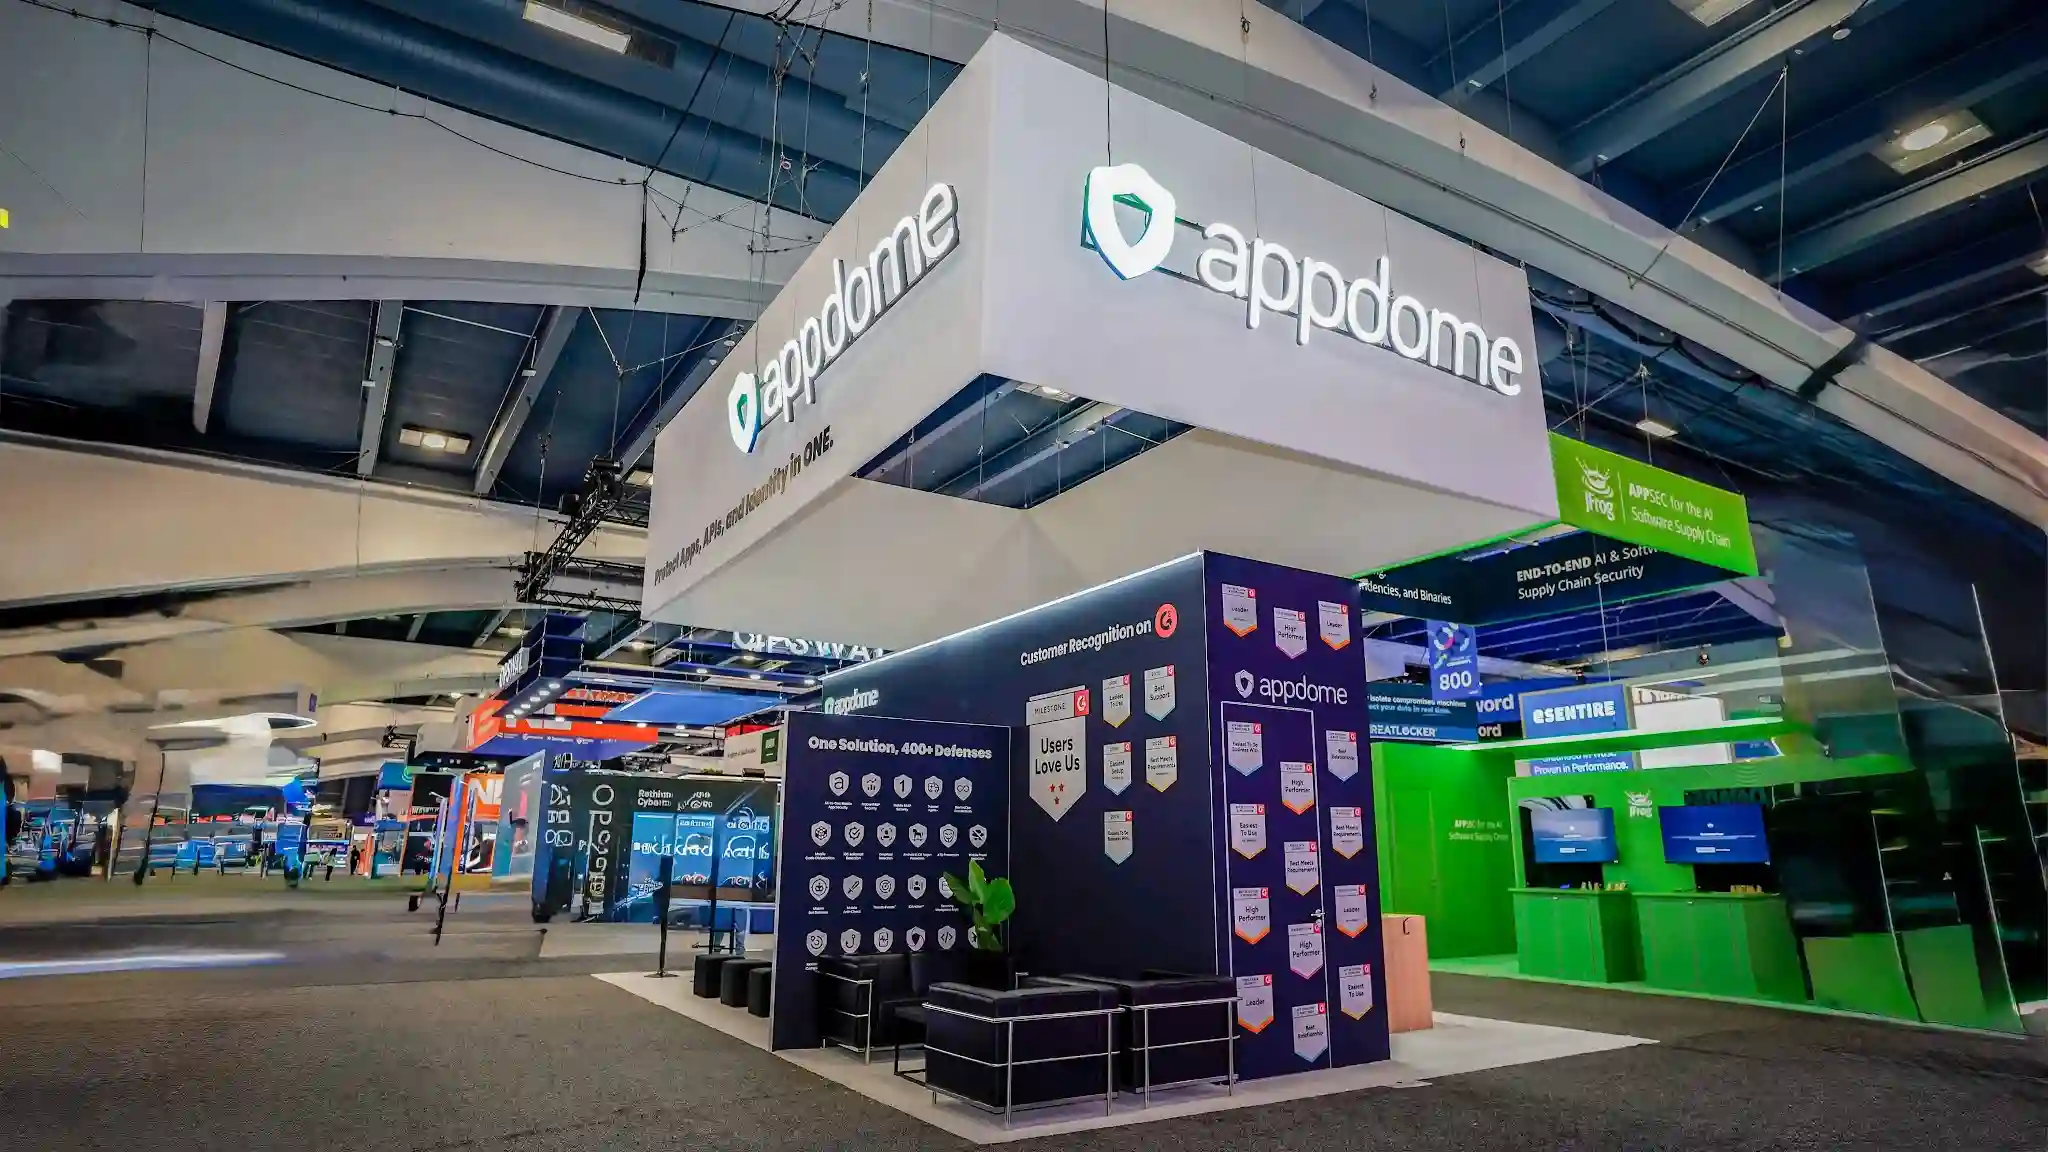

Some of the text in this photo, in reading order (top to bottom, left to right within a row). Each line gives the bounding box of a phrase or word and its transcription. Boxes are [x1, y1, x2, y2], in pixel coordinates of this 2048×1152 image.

[761, 182, 960, 422] appdome
[1198, 222, 1523, 397] appdome
[654, 552, 680, 586] Protect
[679, 538, 702, 569] Apps,
[725, 495, 745, 530] and
[789, 452, 801, 482] in
[803, 424, 834, 467] ONE.
[1629, 482, 1713, 521] APPSEC for the AI
[1631, 506, 1731, 549] Software Supply Chain
[1516, 556, 1592, 582] END-TO-END
[1594, 553, 1607, 566] AI
[1609, 550, 1620, 562] &
[1518, 565, 1644, 600] Supply Chain Security
[1403, 588, 1419, 600] and
[1420, 589, 1452, 605] Binaries
[1020, 641, 1068, 666] Customer
[1069, 623, 1135, 652] Recognition
[1136, 618, 1152, 634] on
[1259, 674, 1348, 704] appdome
[1440, 670, 1472, 691] 800
[1034, 702, 1066, 715] MILESTONE
[1532, 700, 1616, 724] eSENTIRE
[808, 735, 993, 759] One Solution, 400+ Defenses
[1041, 737, 1073, 754] Users
[1035, 754, 1080, 775] Love Us
[1562, 763, 1571, 773] in
[1245, 906, 1259, 914] High
[1292, 950, 1320, 958] Performer
[1299, 941, 1313, 949] High
[1245, 998, 1265, 1007] Leader
